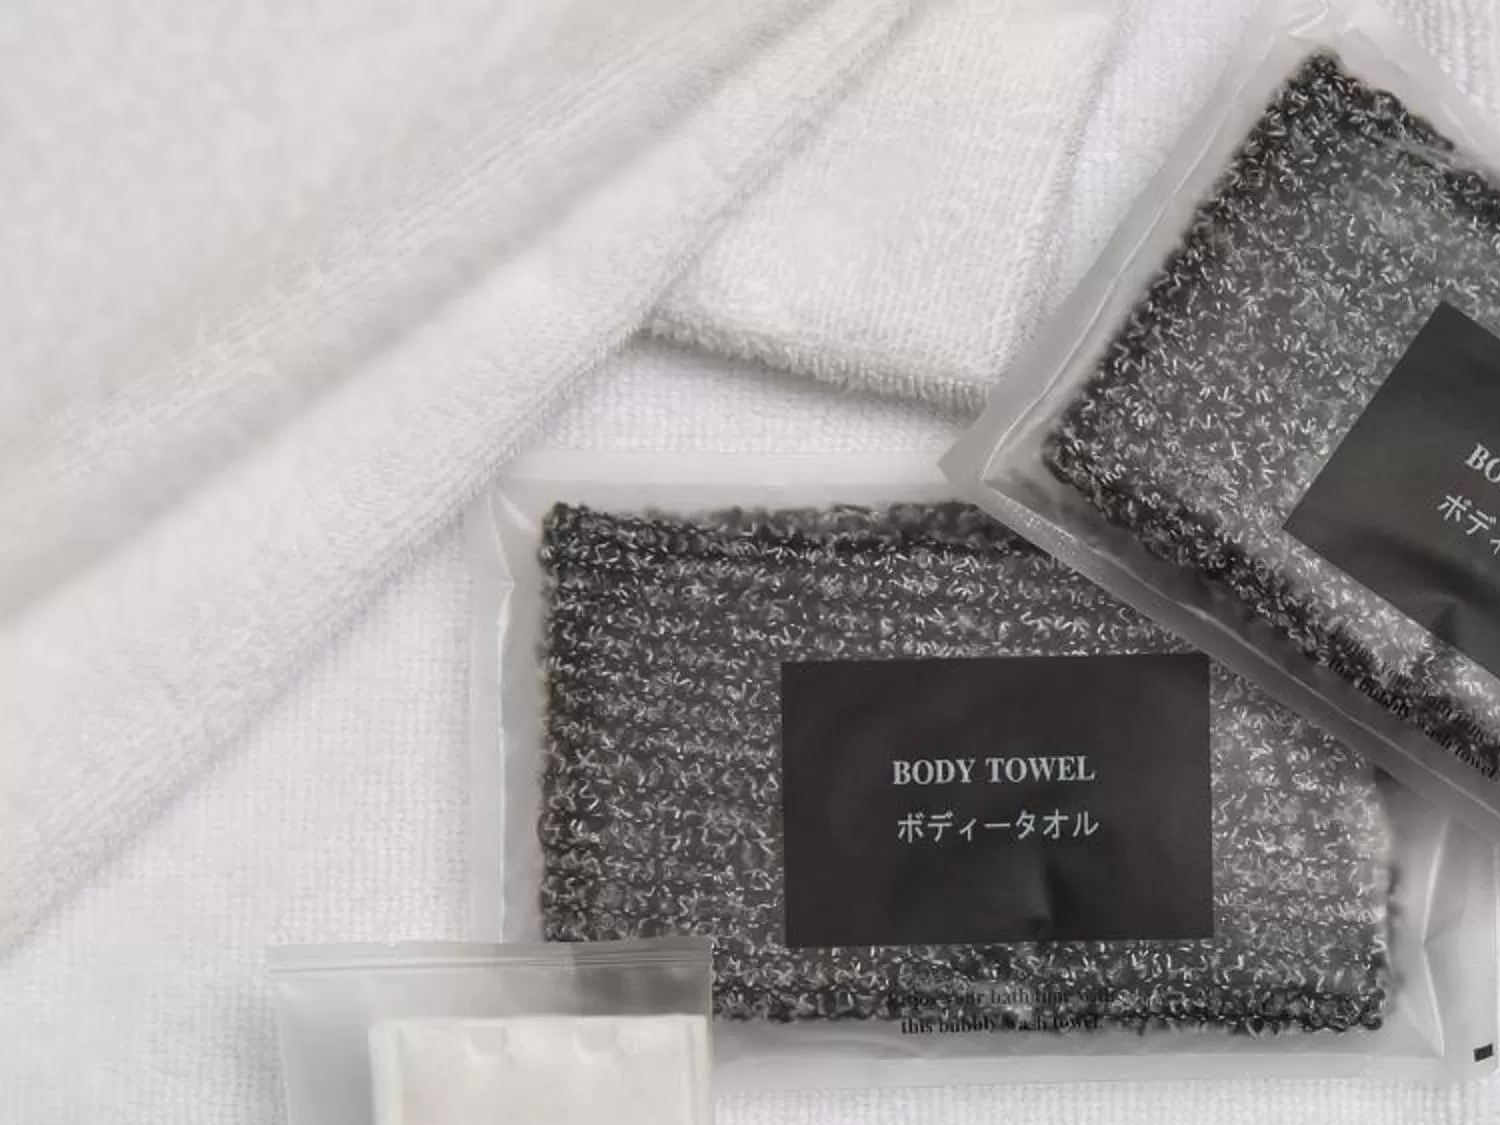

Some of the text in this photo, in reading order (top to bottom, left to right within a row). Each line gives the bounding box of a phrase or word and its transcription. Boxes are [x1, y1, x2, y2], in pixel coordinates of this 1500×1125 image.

[892, 755, 1095, 785] BODY TOWEL
[897, 808, 1099, 843] ボディータオル
